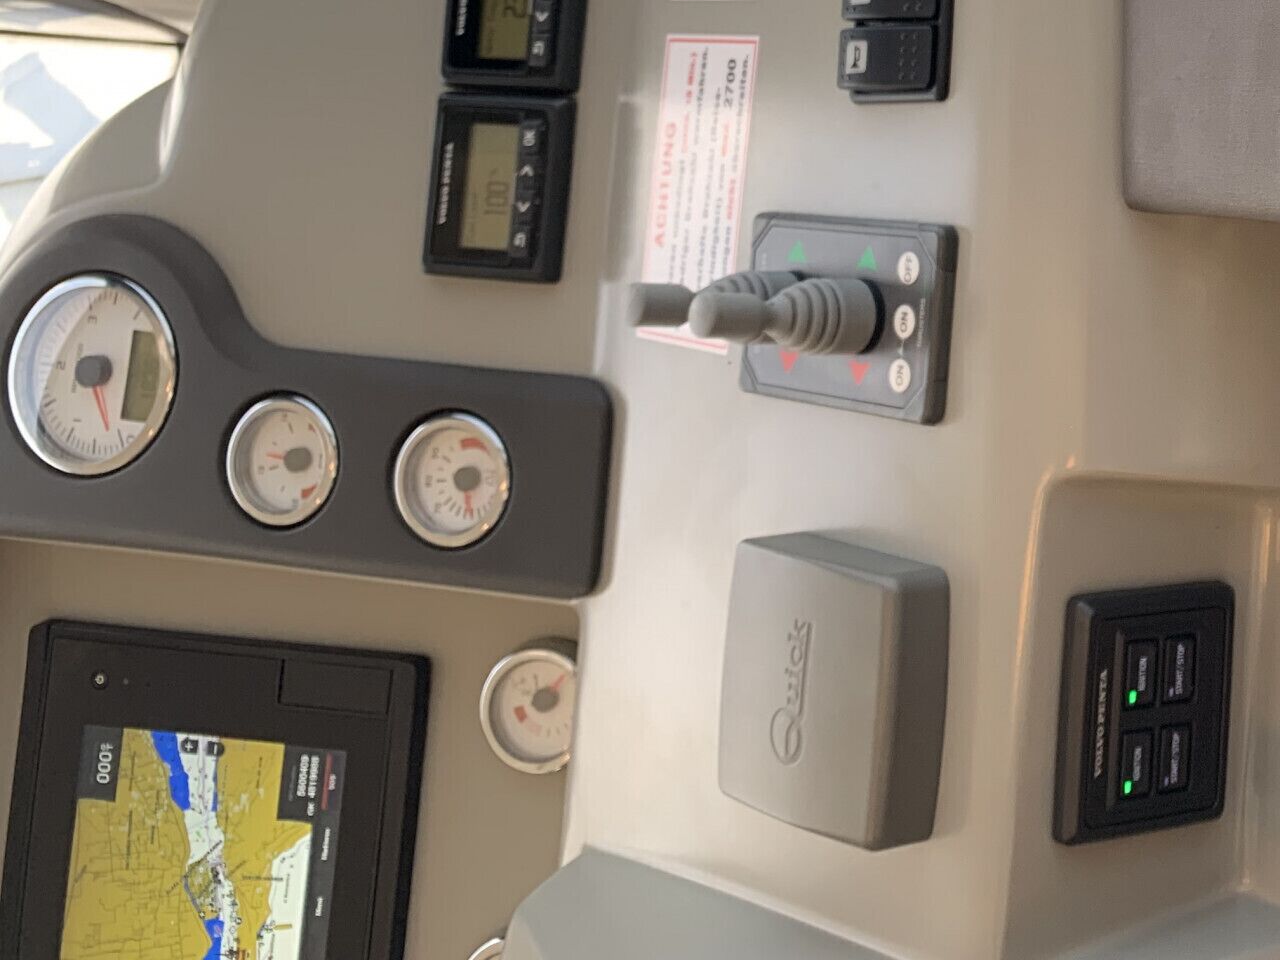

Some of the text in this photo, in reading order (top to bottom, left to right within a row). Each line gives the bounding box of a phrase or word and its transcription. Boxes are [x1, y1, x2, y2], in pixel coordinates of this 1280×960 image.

[722, 58, 737, 108] 2700
[522, 129, 537, 146] OK
[653, 122, 677, 248] ACHTUNG
[904, 255, 913, 283] OFF
[899, 312, 908, 333] ON
[896, 364, 905, 386] ON
[769, 618, 814, 766] Quick
[1137, 656, 1148, 692] IGNITION
[1094, 669, 1108, 778] VOLVO PENTA
[1132, 746, 1142, 782] IGNITION
